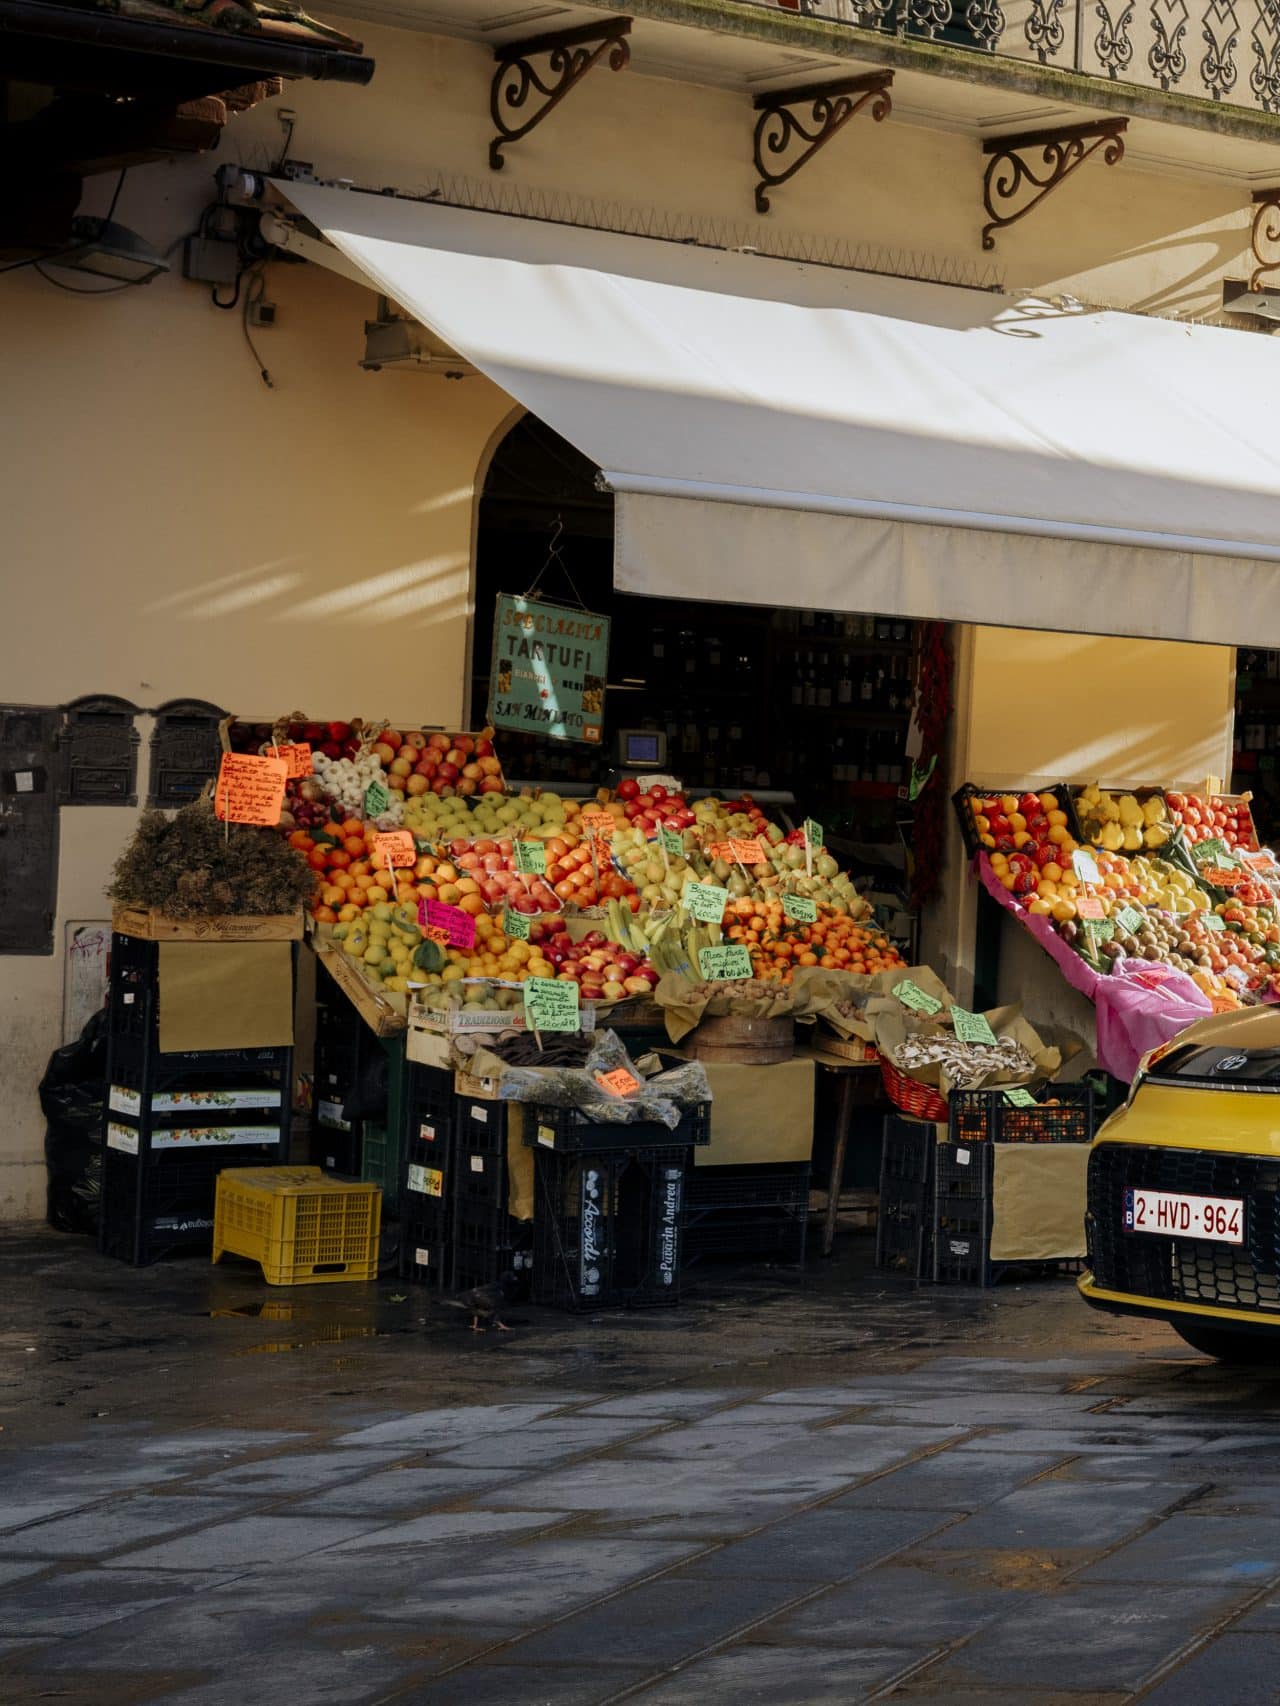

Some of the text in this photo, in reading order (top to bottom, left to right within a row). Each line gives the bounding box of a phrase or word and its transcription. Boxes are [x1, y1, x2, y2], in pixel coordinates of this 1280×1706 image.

[506, 635, 591, 671] TARTUFI
[496, 700, 583, 728] SAN MINIATO
[458, 1014, 512, 1026] TRADIZIONE
[662, 1183, 677, 1225] Andrea
[1126, 1211, 1133, 1225] B
[583, 1200, 600, 1262] Accordi
